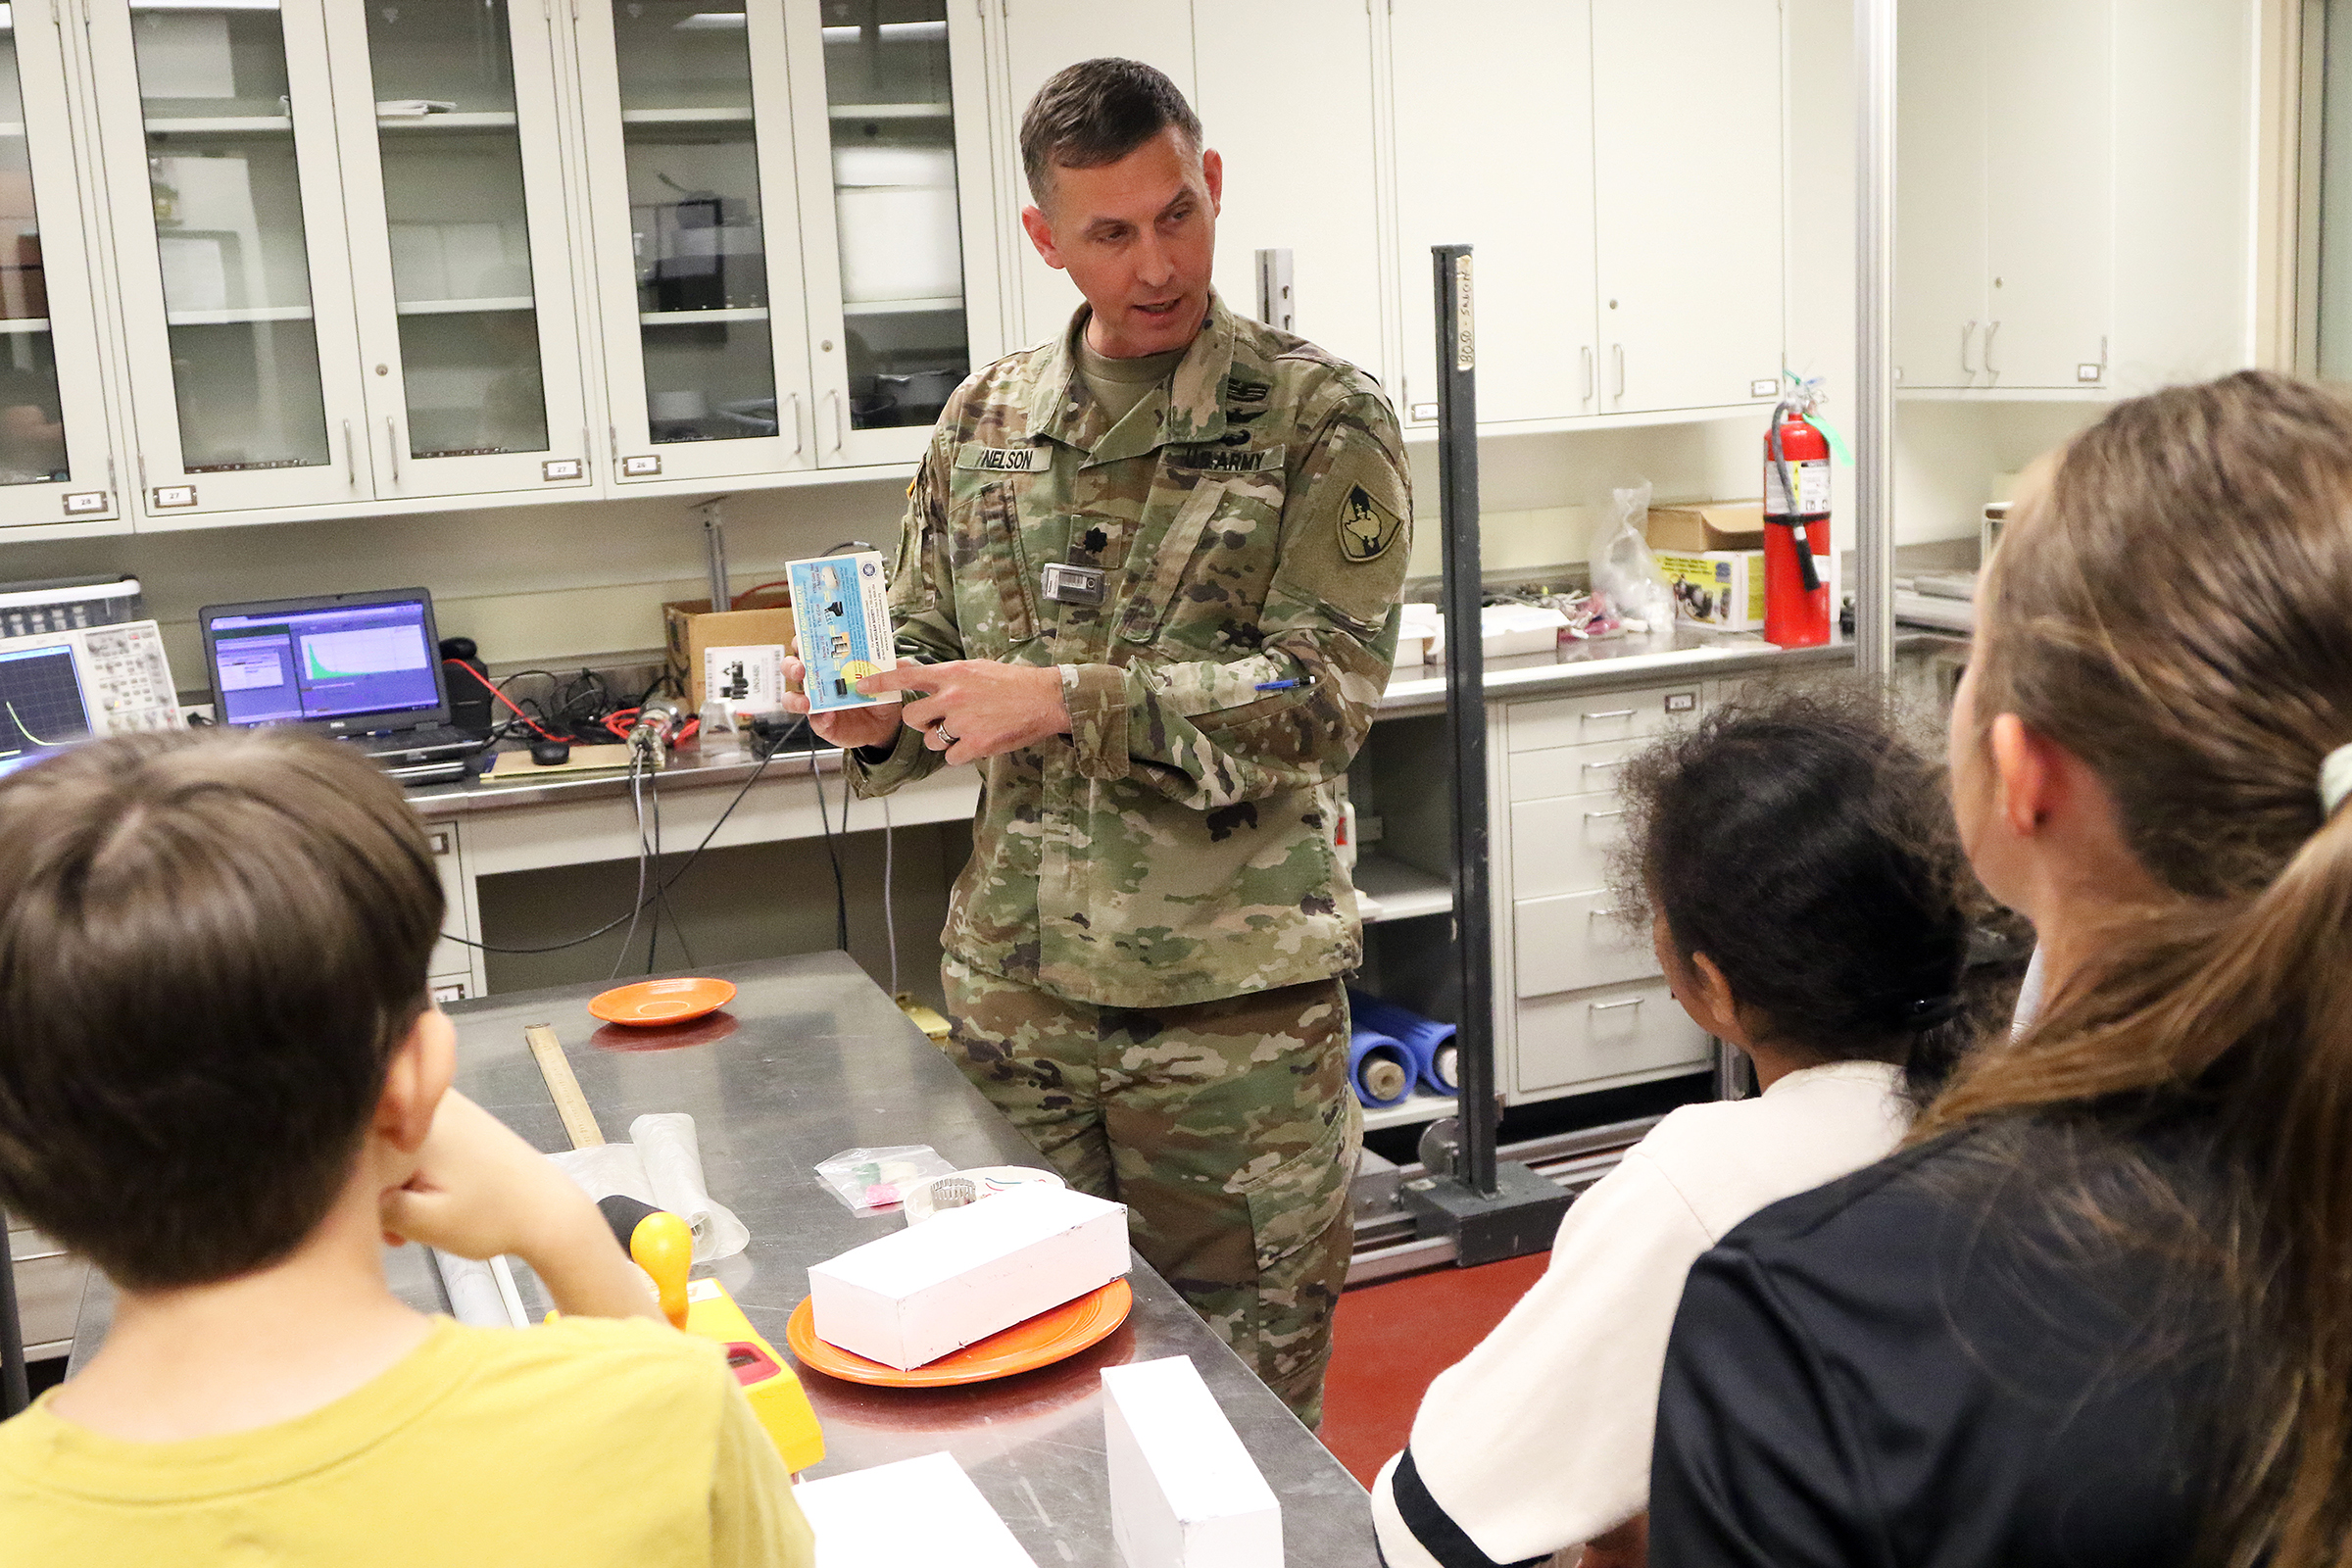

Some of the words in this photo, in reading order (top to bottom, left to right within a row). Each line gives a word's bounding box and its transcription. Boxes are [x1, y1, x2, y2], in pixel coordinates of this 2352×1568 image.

[982, 450, 1033, 469] NELSON
[1216, 451, 1266, 471] ARMY
[802, 632, 810, 660] ENERGY
[807, 662, 815, 689] SOURCE
